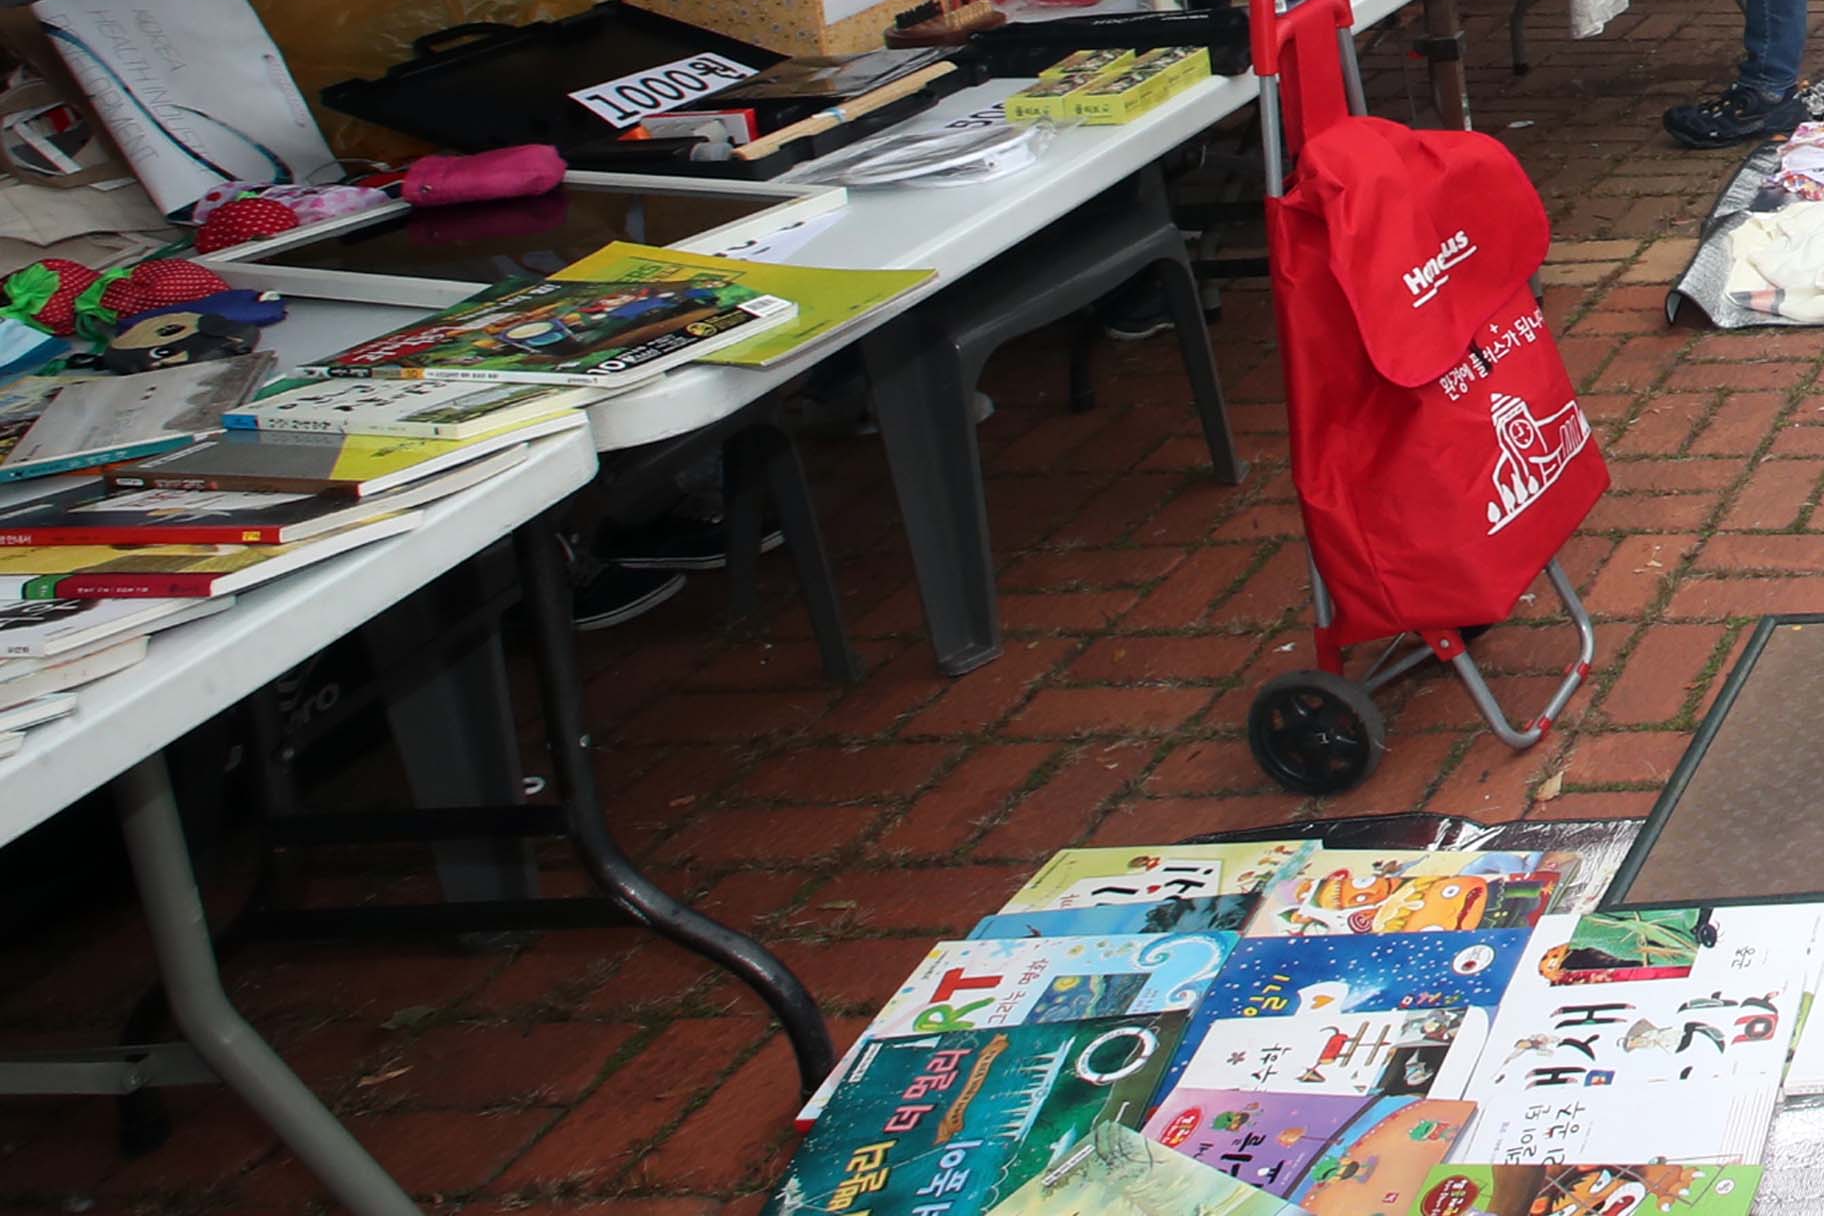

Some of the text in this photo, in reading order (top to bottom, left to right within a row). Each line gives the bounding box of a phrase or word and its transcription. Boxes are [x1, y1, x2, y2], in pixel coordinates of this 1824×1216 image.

[586, 52, 748, 123] 1000원
[911, 966, 1004, 1034] RT
[903, 1047, 973, 1102] 멀리
[884, 1102, 934, 1136] 더
[914, 1139, 985, 1199] 높이
